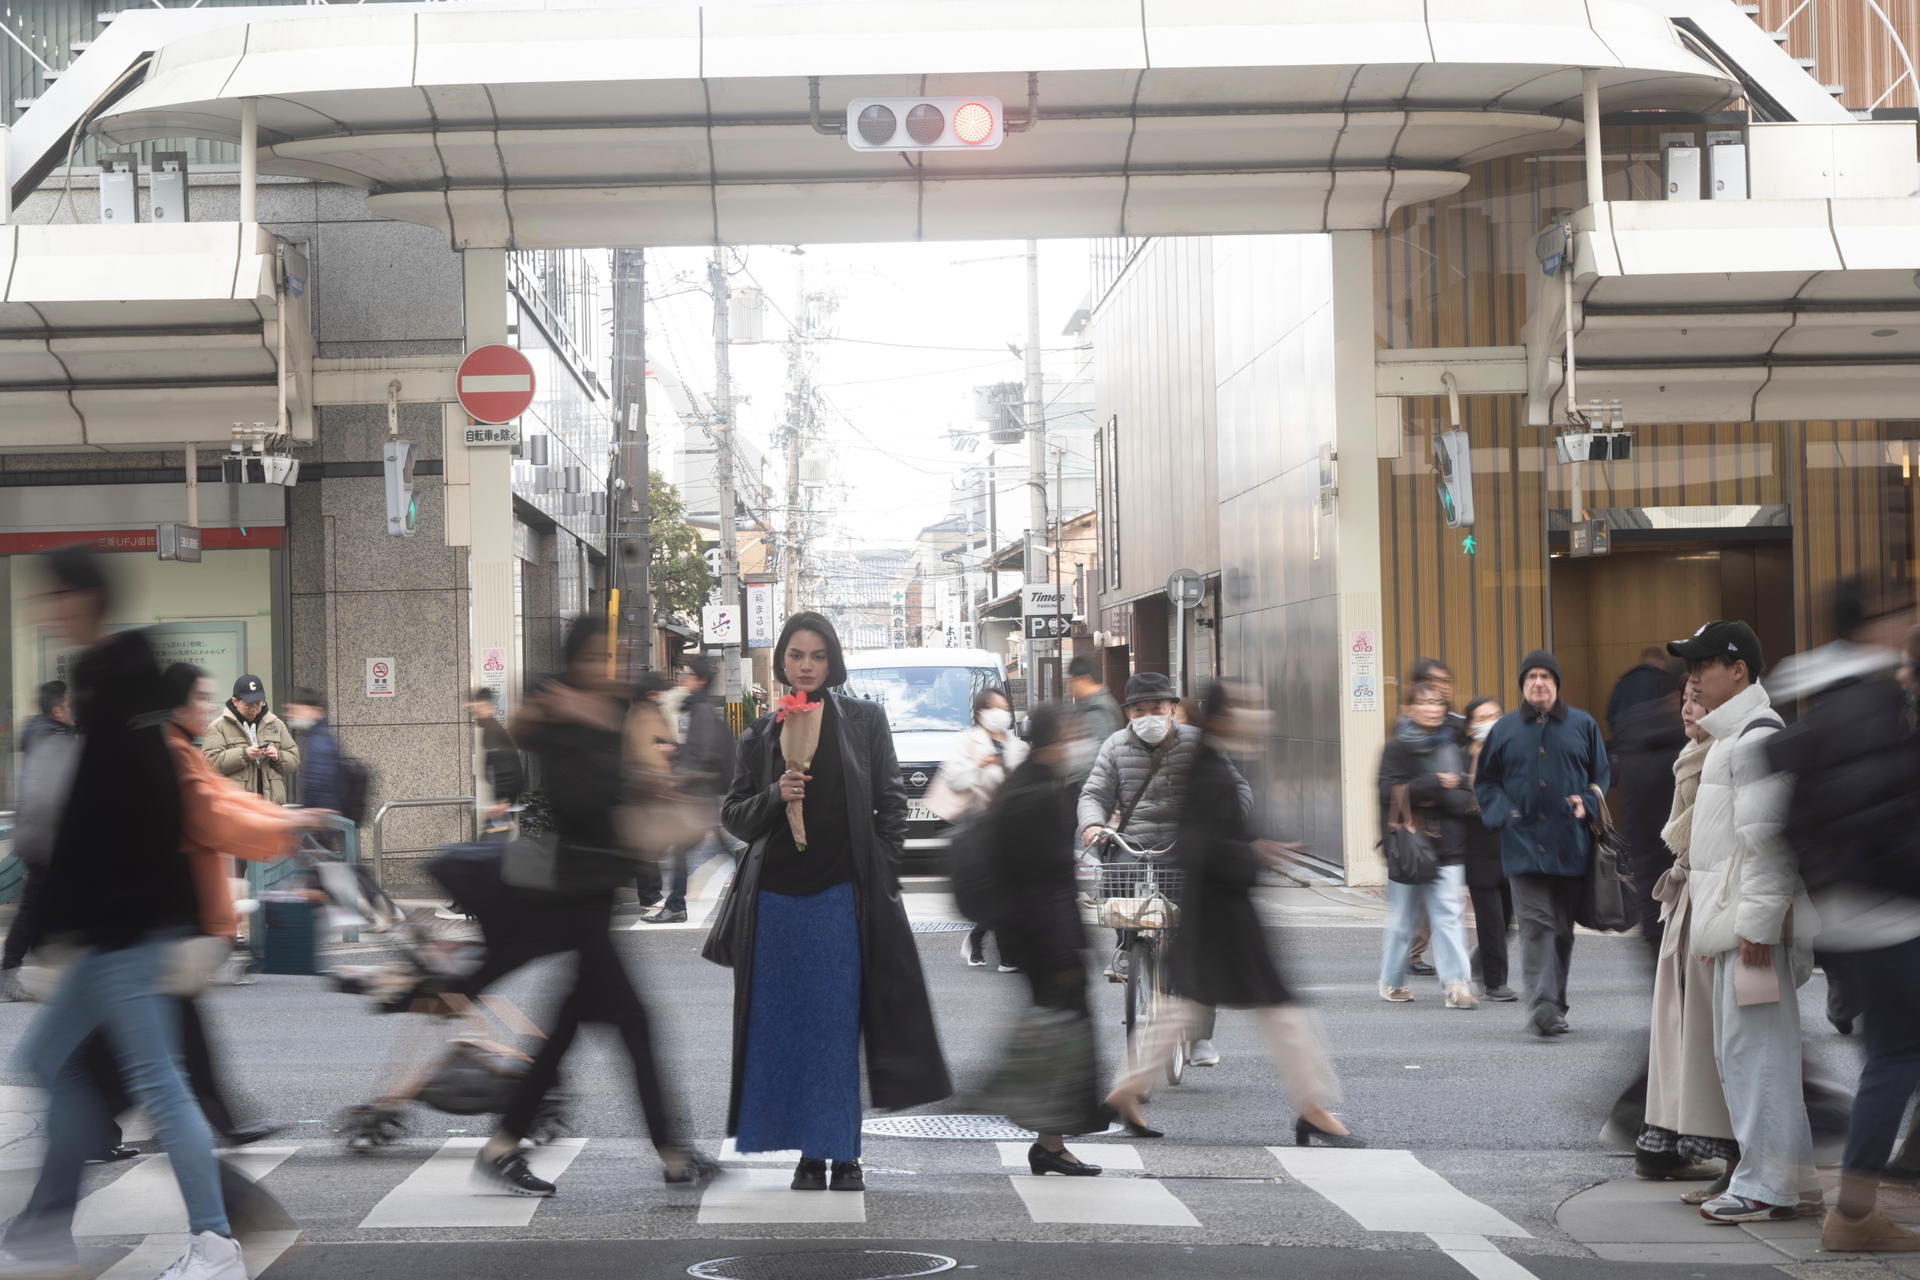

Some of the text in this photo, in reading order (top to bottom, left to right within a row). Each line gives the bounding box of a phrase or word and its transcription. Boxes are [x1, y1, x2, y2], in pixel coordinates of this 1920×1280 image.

[466, 429, 517, 442] 自転車を除く
[1031, 592, 1066, 602] Times
[1031, 617, 1046, 638] P
[249, 681, 256, 691] C
